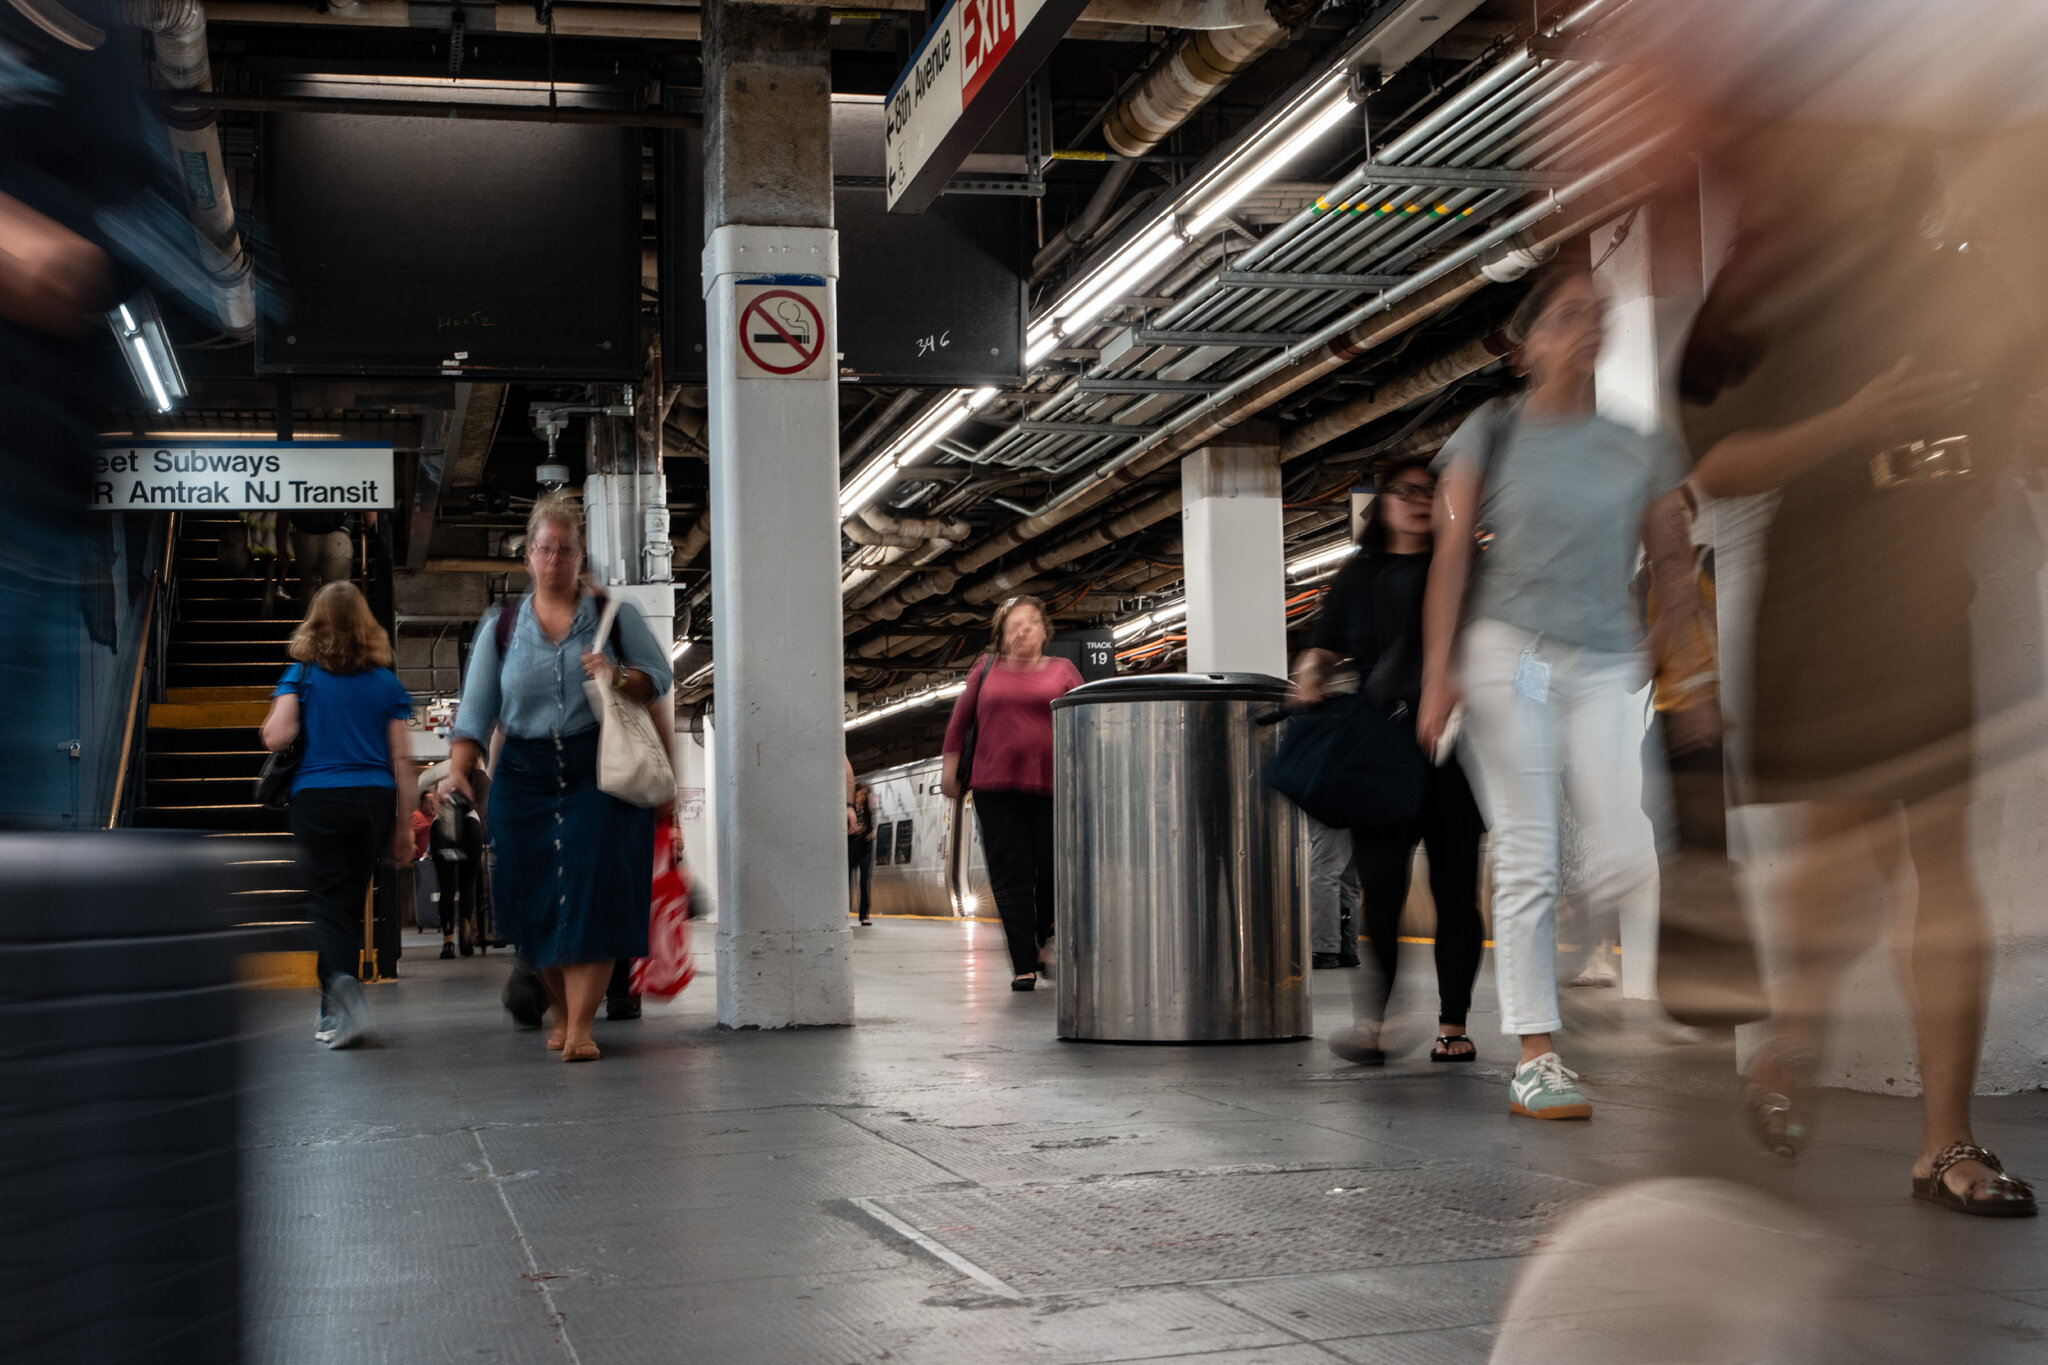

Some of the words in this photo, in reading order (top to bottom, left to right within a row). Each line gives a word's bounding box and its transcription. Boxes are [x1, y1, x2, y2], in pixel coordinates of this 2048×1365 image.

[895, 84, 911, 134] 8th
[915, 29, 951, 108] Avenue
[153, 450, 281, 477] Subways
[129, 481, 230, 504] Amtrak
[245, 481, 281, 504] NJ
[289, 481, 379, 504] Transit
[1086, 641, 1112, 649] TRACK
[1090, 652, 1108, 665] 19
